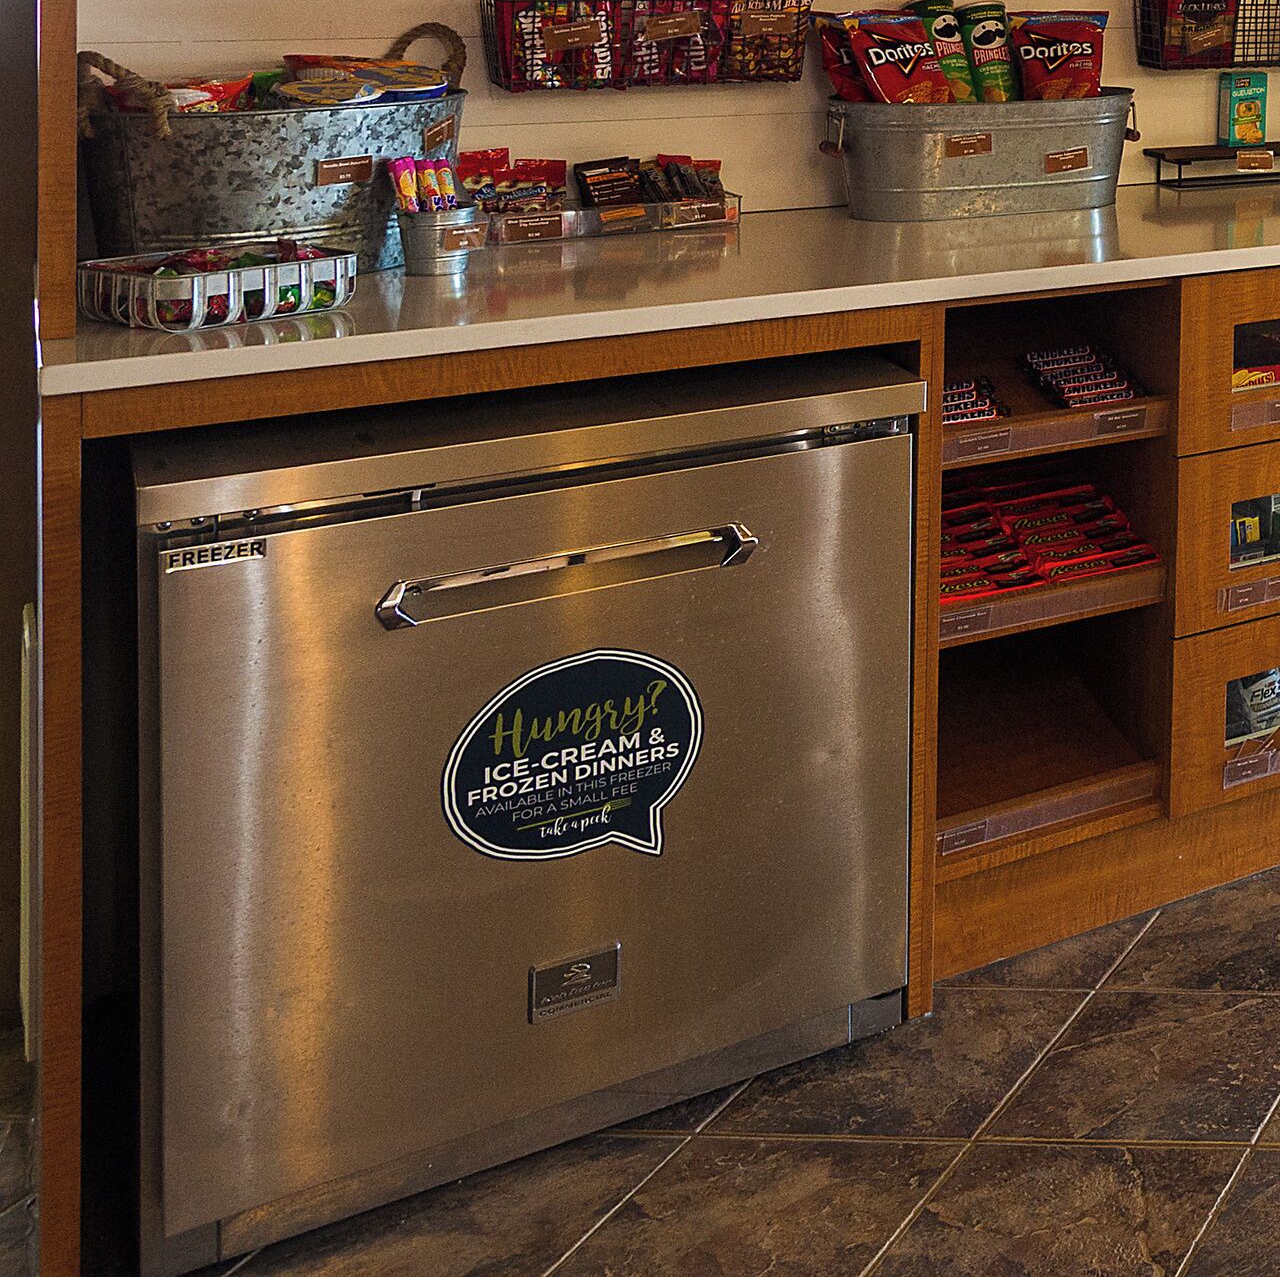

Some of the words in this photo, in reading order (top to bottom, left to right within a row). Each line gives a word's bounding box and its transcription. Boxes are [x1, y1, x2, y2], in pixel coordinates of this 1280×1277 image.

[868, 42, 934, 66] Doritos
[973, 46, 1011, 65] PRINGLES
[1020, 42, 1093, 60] Doritos
[169, 541, 265, 568] FREEZER
[1250, 685, 1276, 702] Flex
[488, 679, 668, 758] Hungry?
[483, 732, 641, 785] ICE-CREAM
[648, 727, 665, 744] &
[467, 771, 568, 807] FROZEN
[575, 742, 680, 781] DINNERS
[475, 793, 554, 819] AVAILABLE
[558, 785, 573, 797] IN
[576, 777, 607, 793] THIS
[610, 762, 672, 785] FREEZER
[512, 806, 543, 822] FOR
[546, 802, 558, 815] A
[560, 793, 609, 812] SMALL
[612, 782, 639, 796] FEE
[540, 817, 570, 838] take
[580, 805, 613, 831] peek
